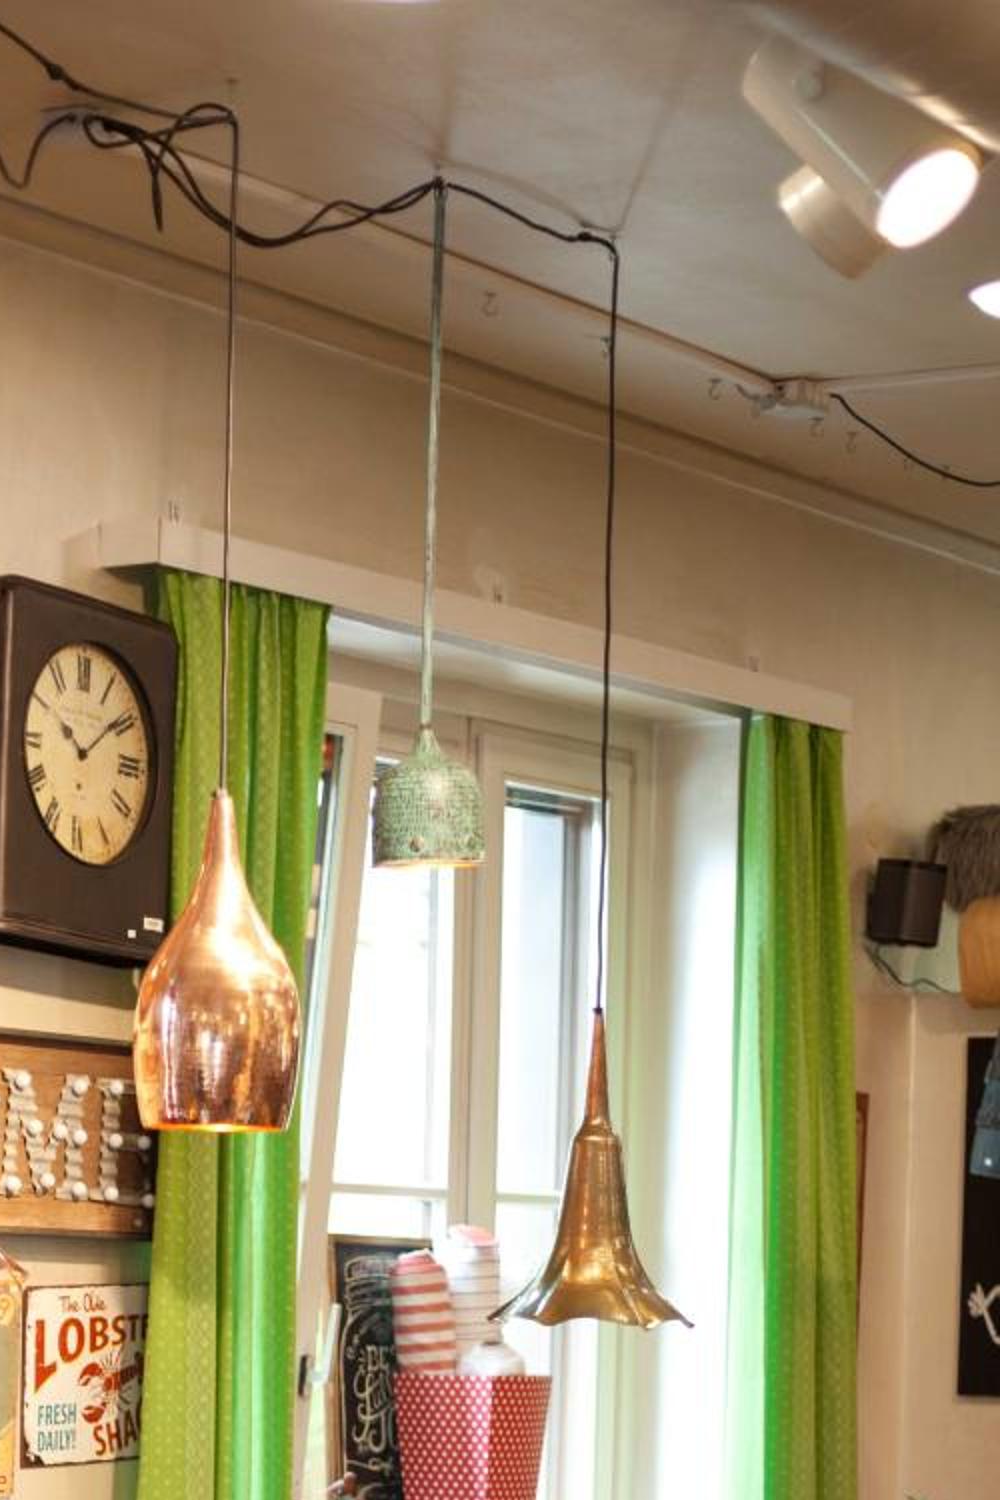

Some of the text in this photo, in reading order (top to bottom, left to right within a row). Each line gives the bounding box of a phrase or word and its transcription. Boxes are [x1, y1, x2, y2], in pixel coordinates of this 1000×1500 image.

[59, 1295, 79, 1312] The
[38, 1403, 77, 1427] FRESH
[37, 1429, 76, 1453] DAILY!
